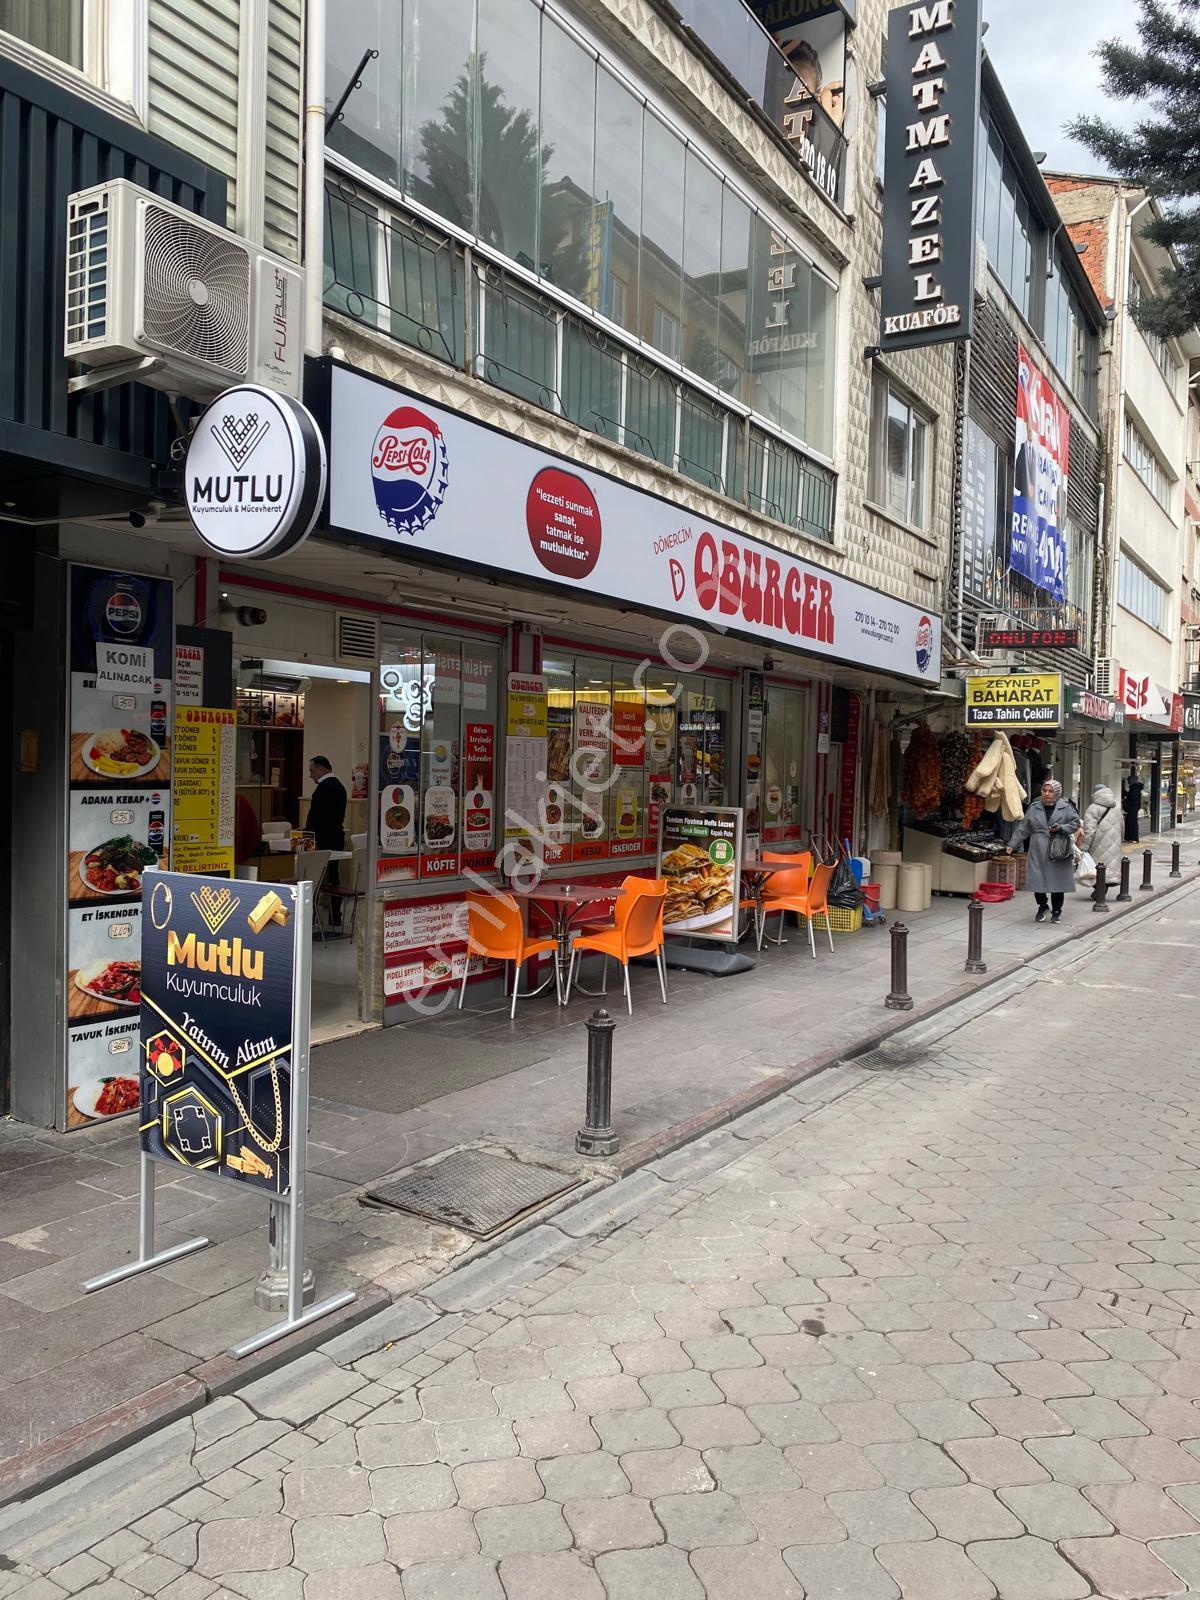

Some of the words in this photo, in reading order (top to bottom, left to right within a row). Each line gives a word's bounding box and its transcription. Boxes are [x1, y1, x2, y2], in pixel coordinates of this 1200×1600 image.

[884, 304, 961, 335] KUAFÖR
[193, 474, 283, 503] MUTLU
[192, 505, 233, 515] Kuyumculuk
[234, 505, 239, 513] &
[241, 504, 282, 513] Mücevherat
[565, 500, 594, 518] sunmak
[554, 511, 578, 528] sanat,
[546, 524, 573, 542] tatmak
[573, 531, 584, 545] ise
[693, 531, 836, 645] OBURGER
[108, 606, 139, 619] PEPSI
[106, 649, 147, 668] KOMİ
[99, 670, 152, 685] ALINACAK
[986, 678, 1041, 689] ZEYNEP
[972, 689, 1054, 703] BAHARAT
[973, 708, 994, 720] Taze
[995, 707, 1021, 720] Tahin
[1023, 707, 1054, 722] Çekilir
[473, 726, 488, 734] Odun
[81, 796, 114, 805] ADANA
[115, 795, 145, 804] KEBAP
[426, 857, 456, 872] KÖFTE
[82, 913, 94, 922] ET
[95, 908, 139, 920] İSKENDER
[385, 920, 404, 929] Döner
[385, 930, 406, 939] Adana
[167, 930, 264, 981] Mutlu
[166, 971, 262, 1008] Kuyumculuk
[71, 1029, 103, 1043] TAVUK
[180, 1011, 230, 1069] Yatırım
